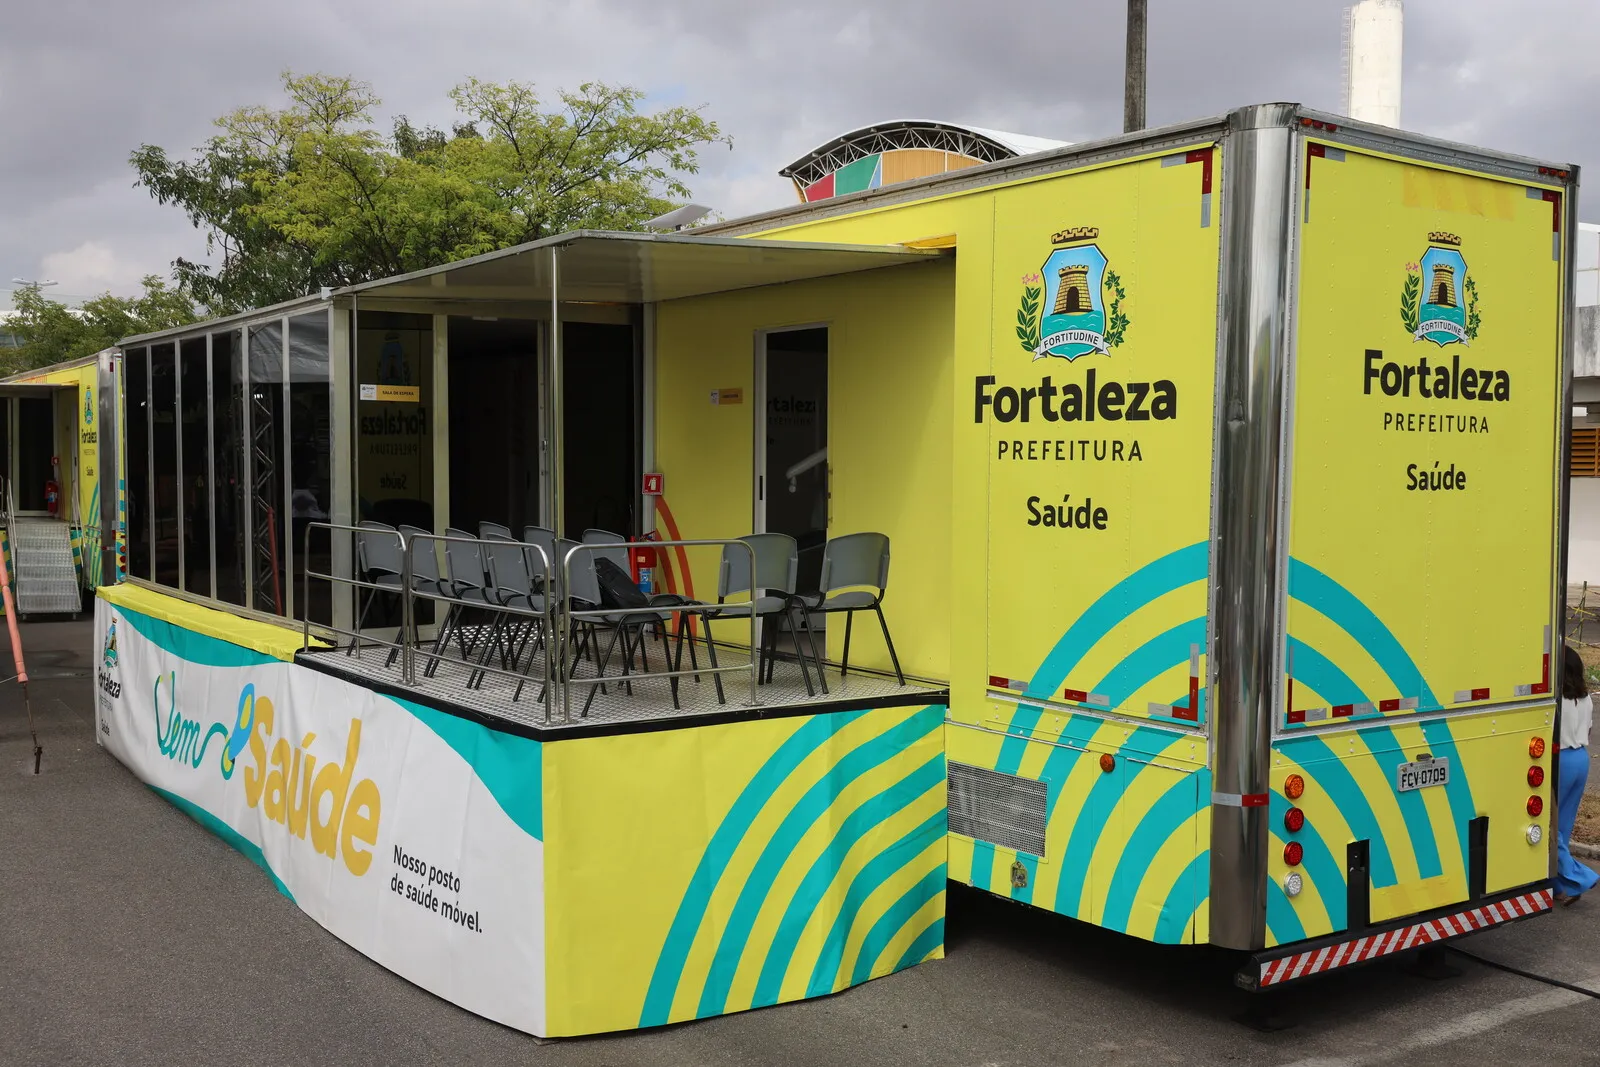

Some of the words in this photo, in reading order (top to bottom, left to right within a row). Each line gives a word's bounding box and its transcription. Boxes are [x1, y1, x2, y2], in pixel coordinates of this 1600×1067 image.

[1043, 332, 1099, 349] FORTITUDINE
[1421, 321, 1462, 336] FORTITUDINE
[1363, 349, 1510, 402] Fortaleza
[974, 368, 1177, 424] Fortaleza
[1383, 412, 1489, 434] PREFEITURA
[998, 440, 1143, 462] PREFEITURA
[1406, 461, 1467, 491] Saúde
[1027, 494, 1108, 530] Saúde
[244, 696, 381, 876] Saúde
[393, 844, 427, 877] Nosso
[428, 865, 461, 893] posto
[390, 872, 404, 895] de
[405, 883, 438, 912] saúde
[440, 900, 482, 933] móvel.
